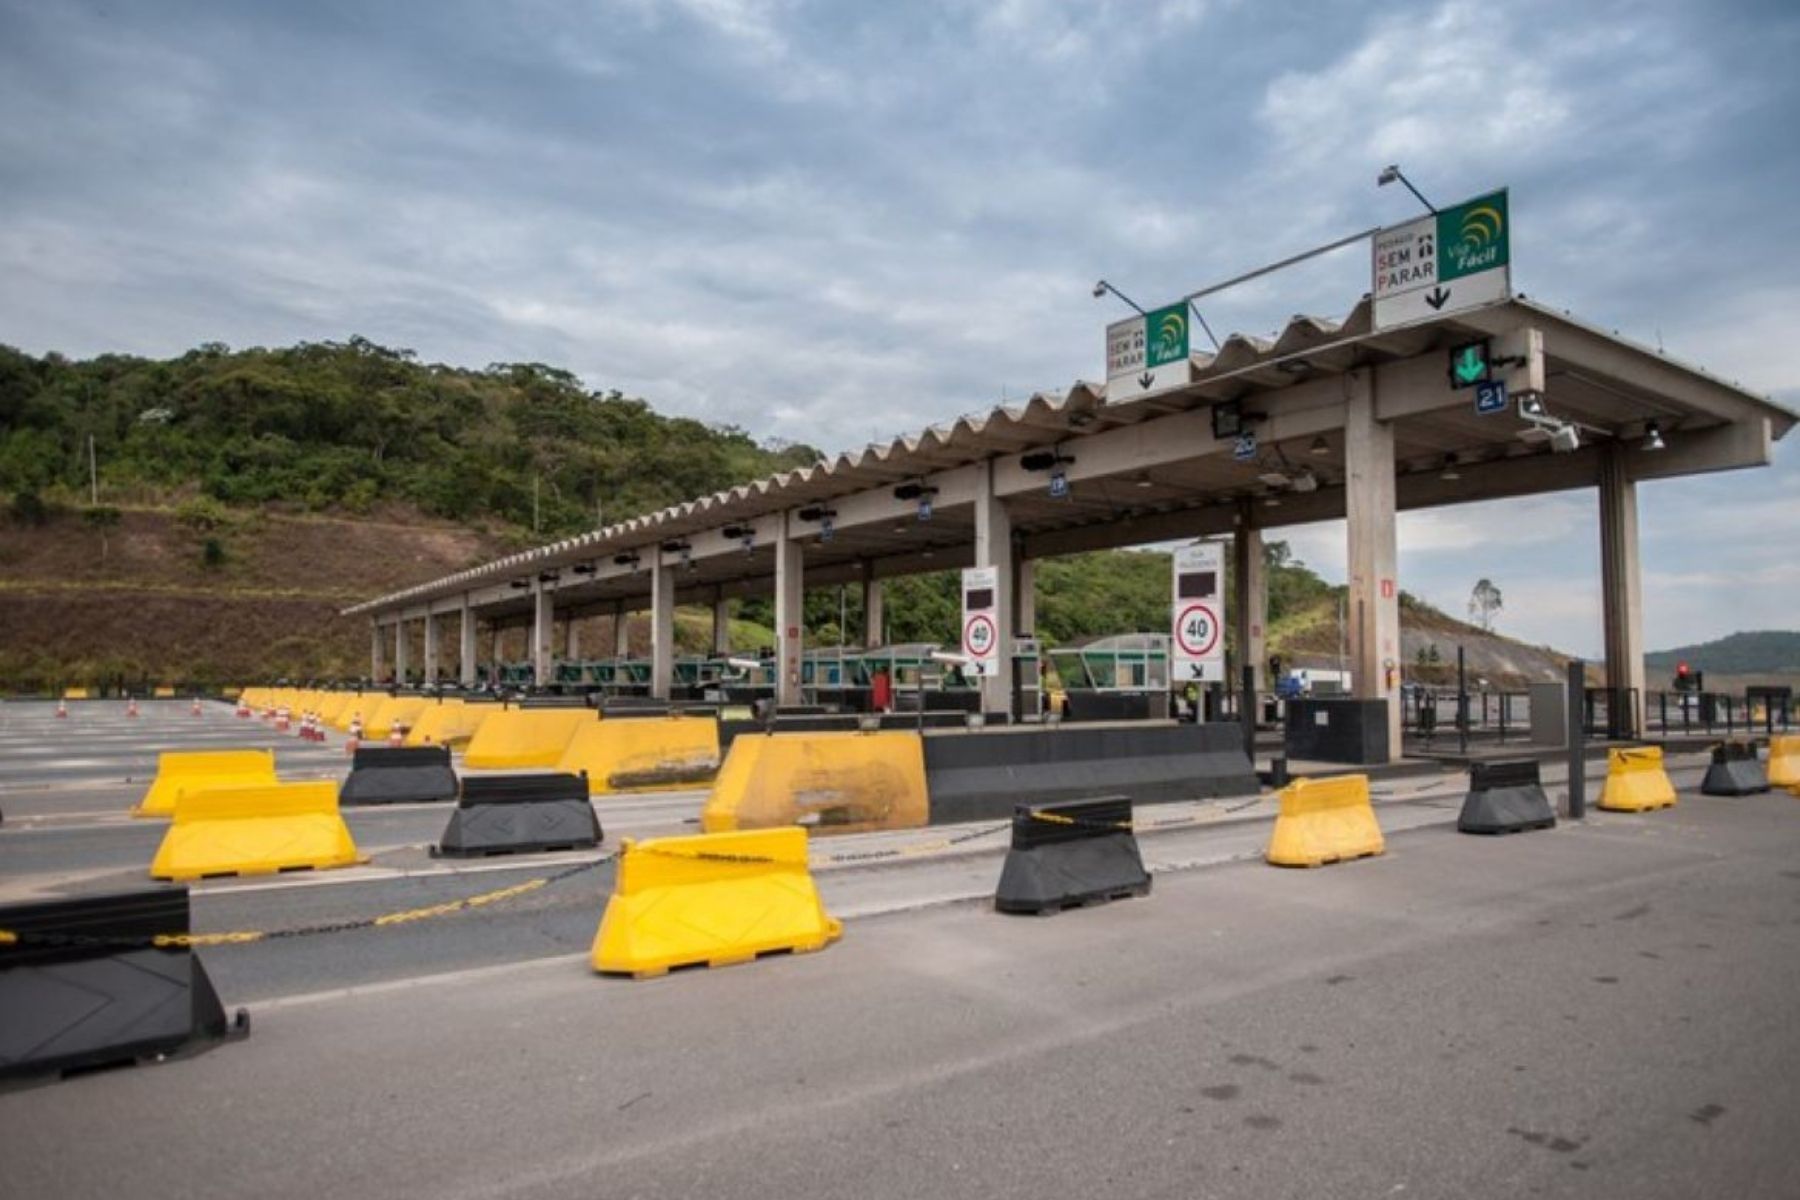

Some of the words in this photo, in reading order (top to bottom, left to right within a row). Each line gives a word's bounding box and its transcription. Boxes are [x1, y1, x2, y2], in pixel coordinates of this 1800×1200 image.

[1378, 247, 1411, 271] SEM
[1378, 261, 1433, 291] PARAR
[1479, 385, 1503, 408] 21
[973, 624, 989, 641] 40
[1187, 619, 1209, 638] 40
